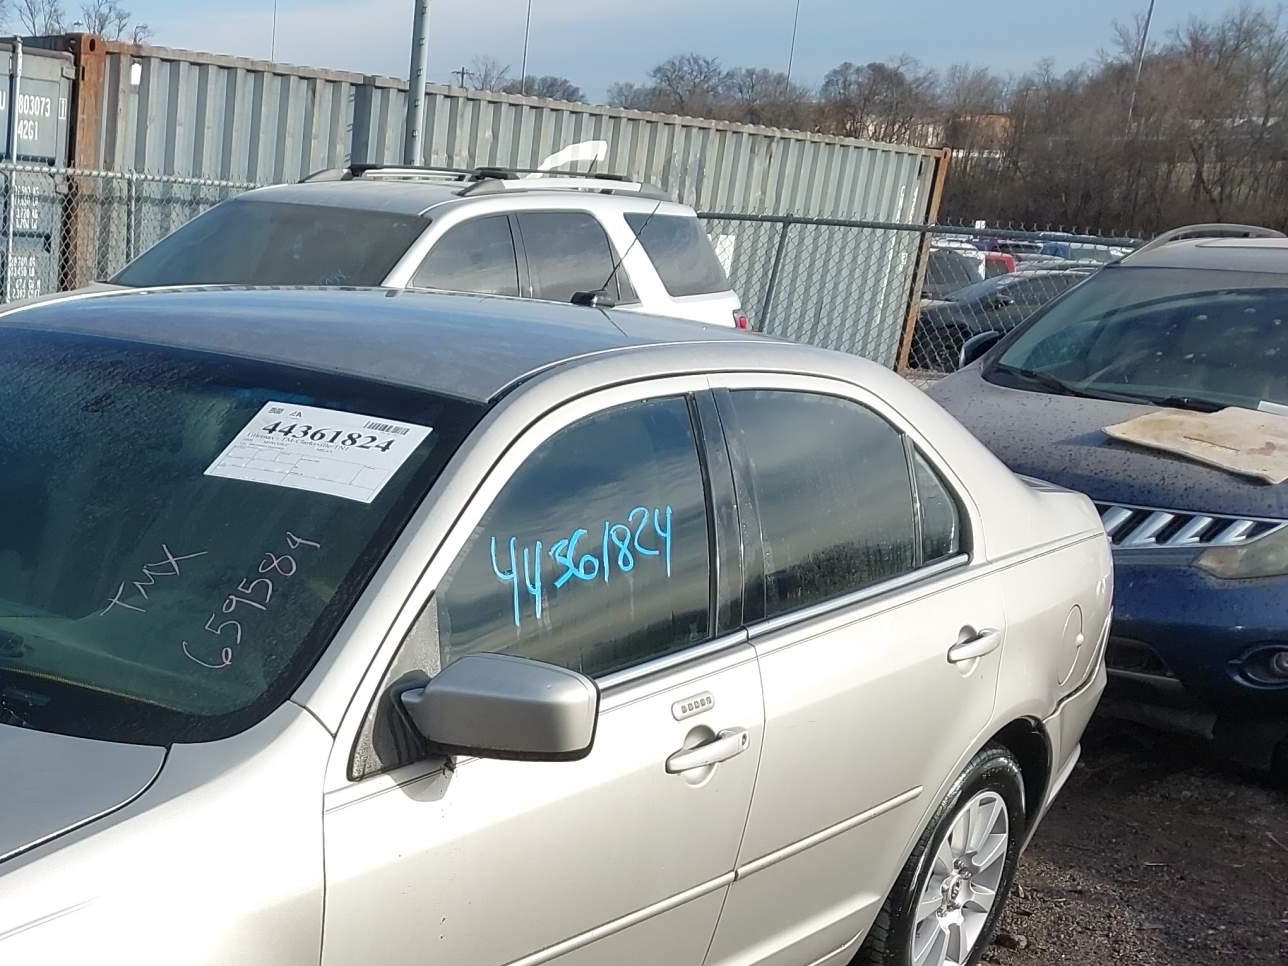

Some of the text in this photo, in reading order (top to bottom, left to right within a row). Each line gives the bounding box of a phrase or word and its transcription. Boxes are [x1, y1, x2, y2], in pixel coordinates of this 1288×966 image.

[18, 94, 51, 117] 803073
[18, 120, 39, 140] 42G1
[262, 420, 394, 453] 44361824
